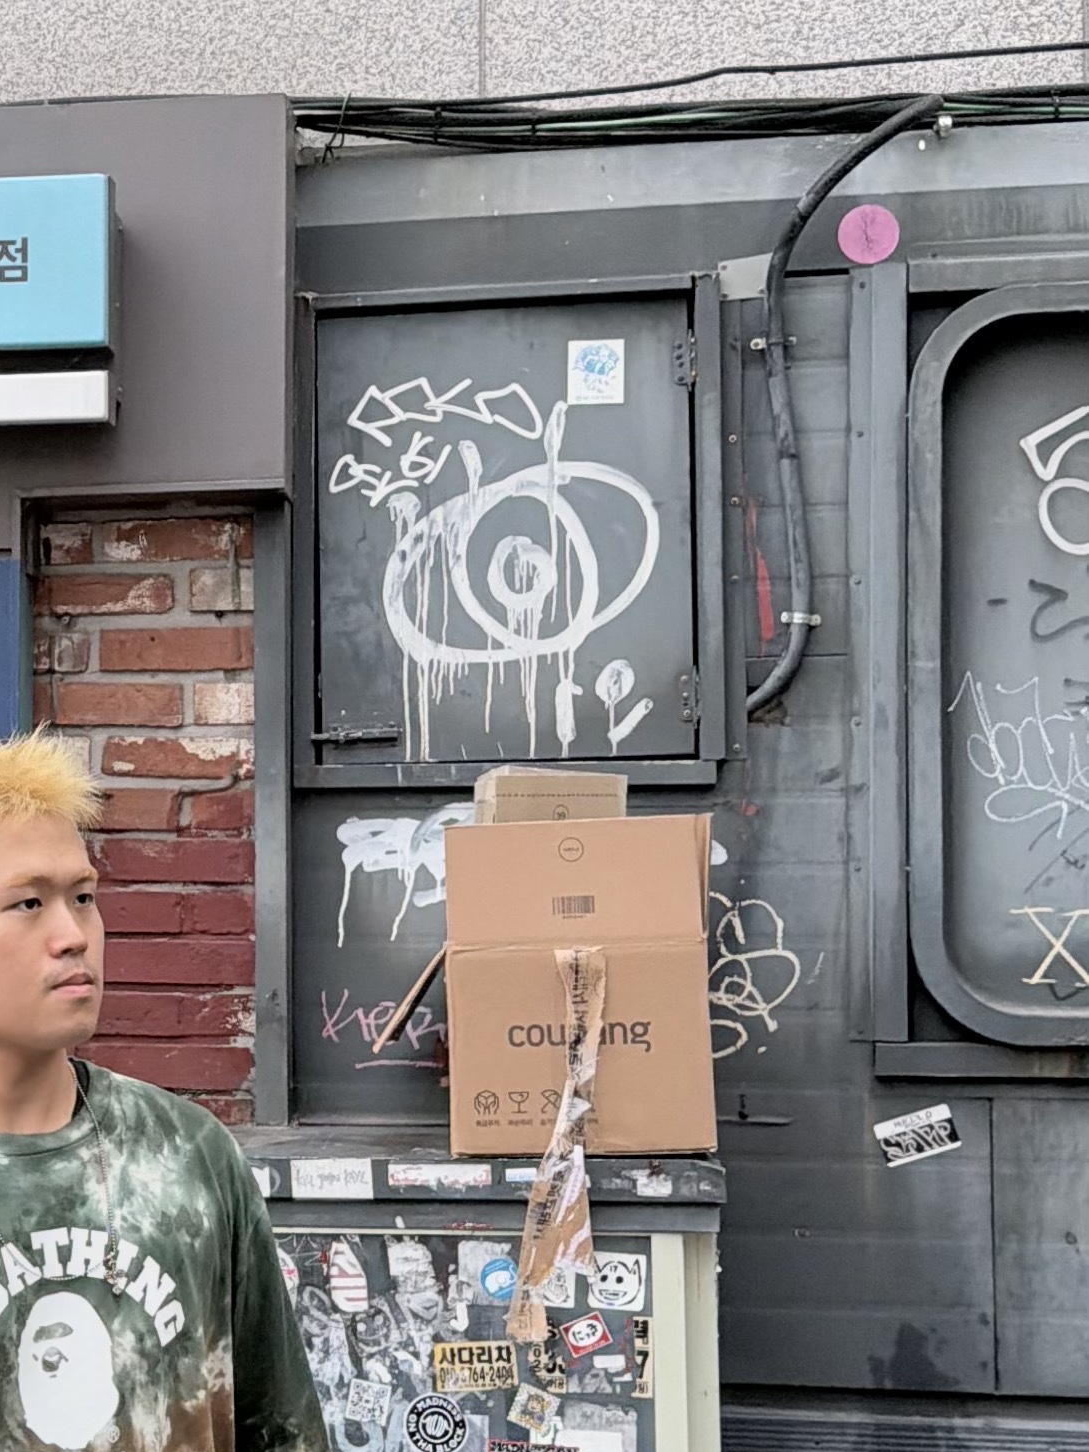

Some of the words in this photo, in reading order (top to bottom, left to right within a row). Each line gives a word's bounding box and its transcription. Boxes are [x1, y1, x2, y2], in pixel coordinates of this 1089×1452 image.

[507, 1021, 652, 1053] coung
[439, 1345, 512, 1366] 사다리차
[415, 1397, 463, 1422] MADNESS
[408, 1413, 418, 1432] ON
